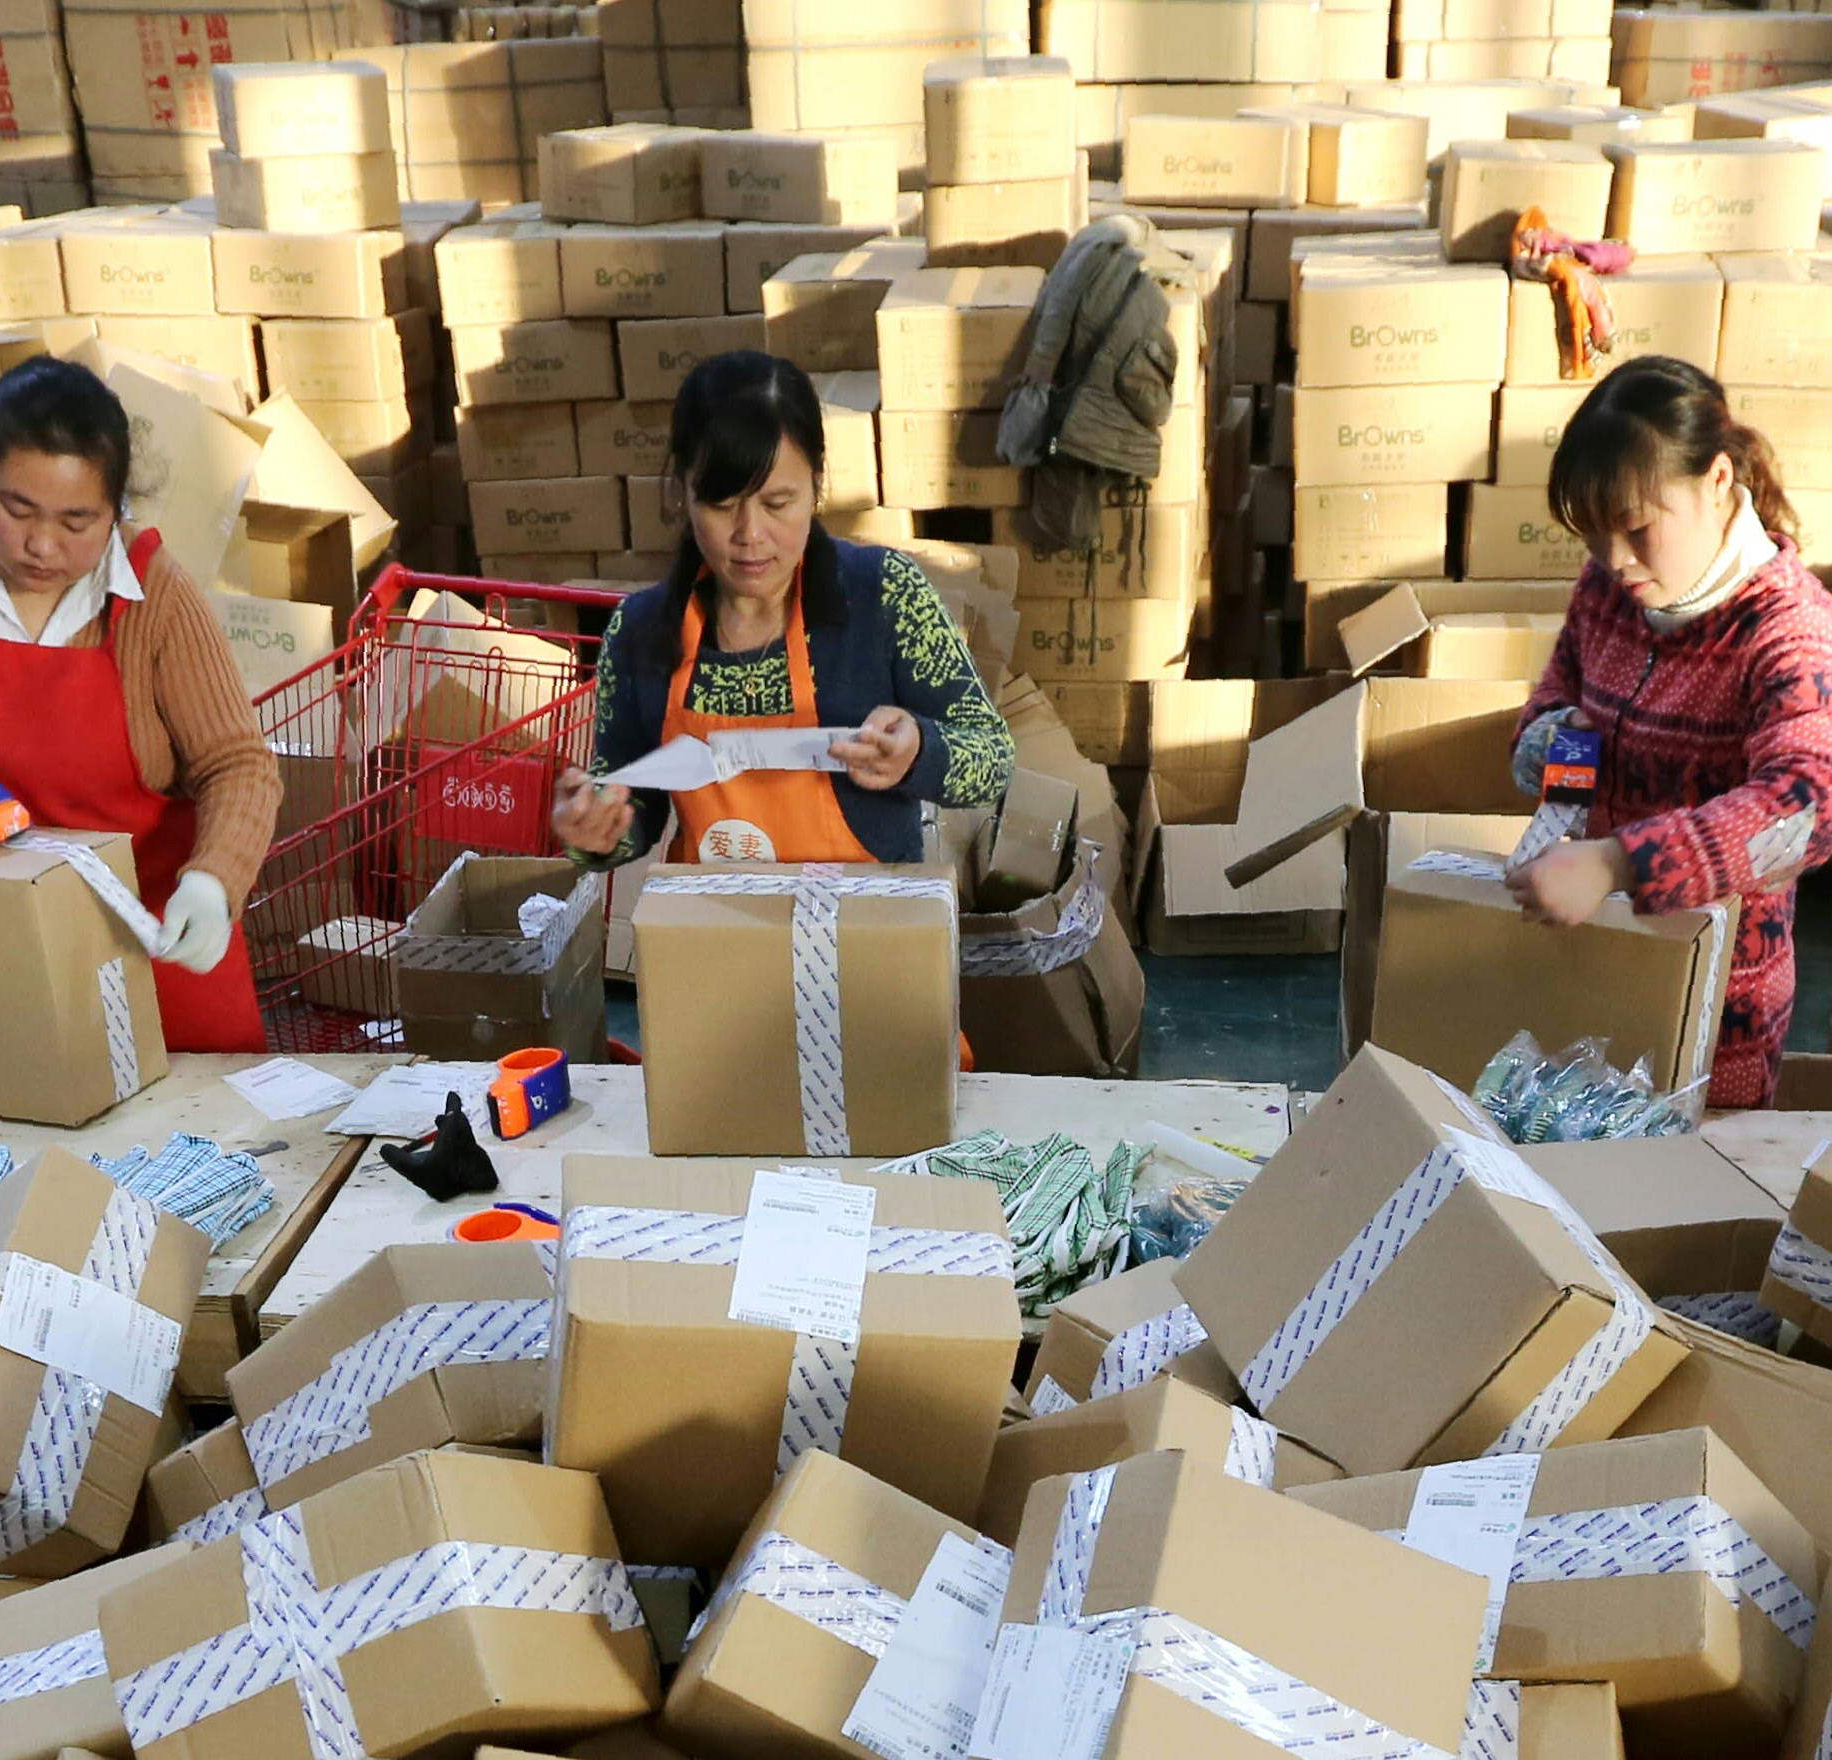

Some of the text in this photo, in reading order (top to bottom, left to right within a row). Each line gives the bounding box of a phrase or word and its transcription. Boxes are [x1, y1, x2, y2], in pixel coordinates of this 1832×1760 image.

[1163, 156, 1230, 175] BrOwns
[1671, 195, 1755, 215] BrOwns
[99, 265, 165, 285] BrOwns
[249, 264, 316, 285] BrOwns
[594, 268, 665, 288] BrOwns
[1350, 325, 1438, 347] BrOwns
[1338, 425, 1424, 447] BrOwns
[230, 626, 295, 653] BrOwn
[710, 831, 763, 860] 爱妻
